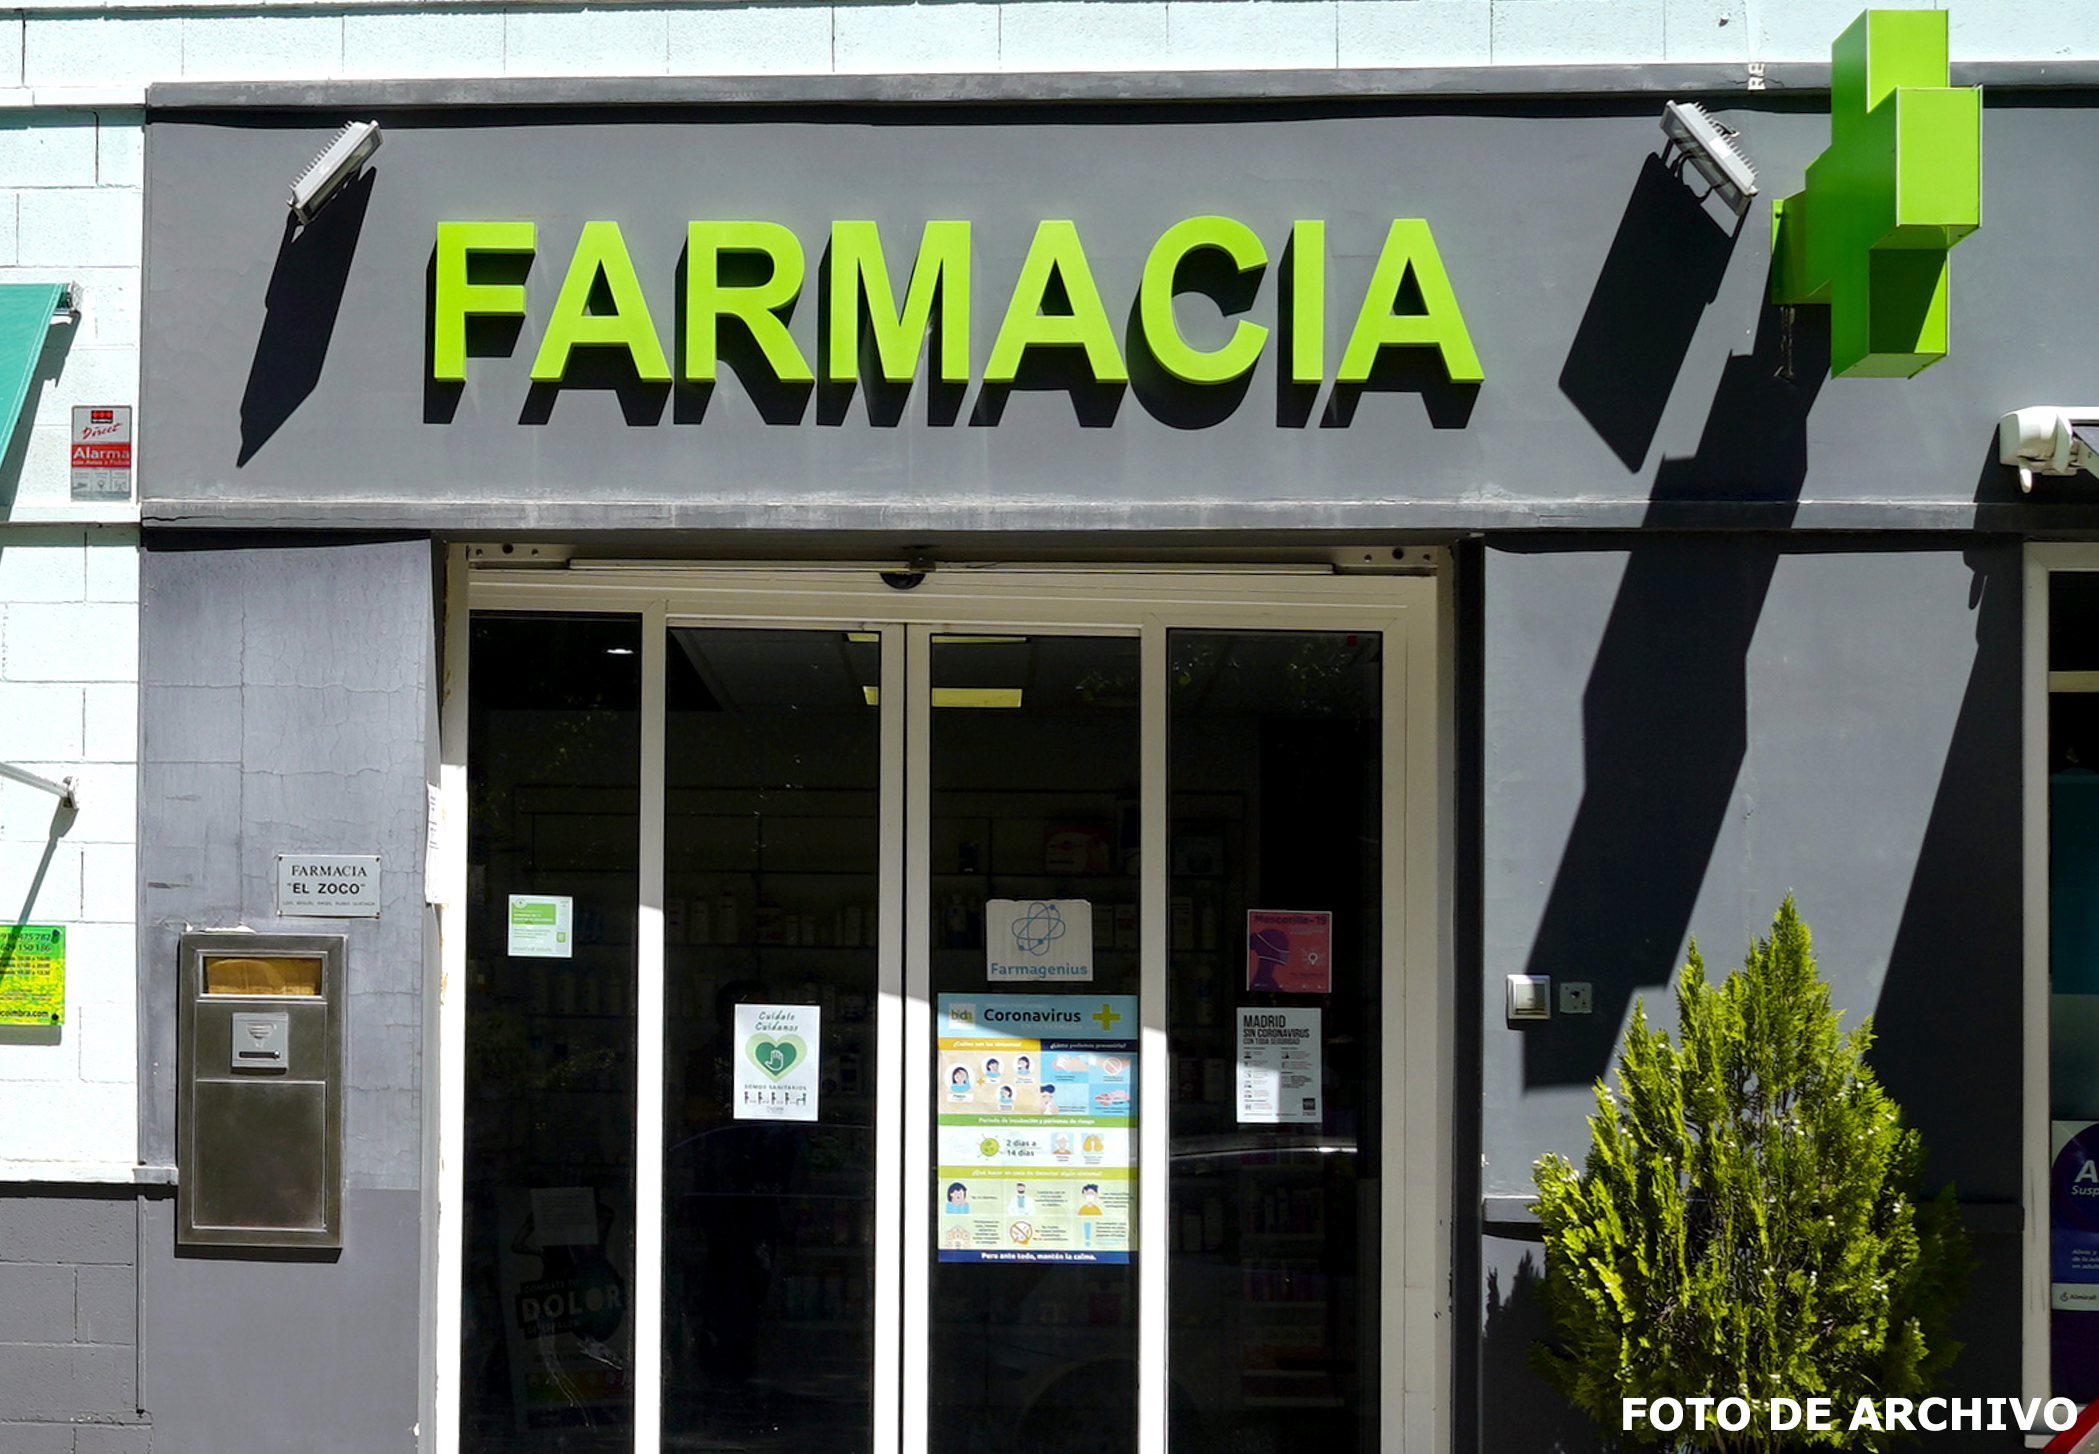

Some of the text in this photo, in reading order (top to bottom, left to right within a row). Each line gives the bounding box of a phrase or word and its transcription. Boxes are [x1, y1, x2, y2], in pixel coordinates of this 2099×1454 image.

[434, 215, 1484, 385] FARMACIA
[73, 447, 130, 459] Alarma
[291, 865, 367, 877] FARMACIA
[990, 963, 1088, 978] Farmagenius
[0, 1008, 48, 1017] coimbra.com
[984, 1008, 1082, 1023] Coronavirus
[1243, 1014, 1287, 1028] MADRID
[1243, 1028, 1310, 1039] SIN CORONAVIRUS
